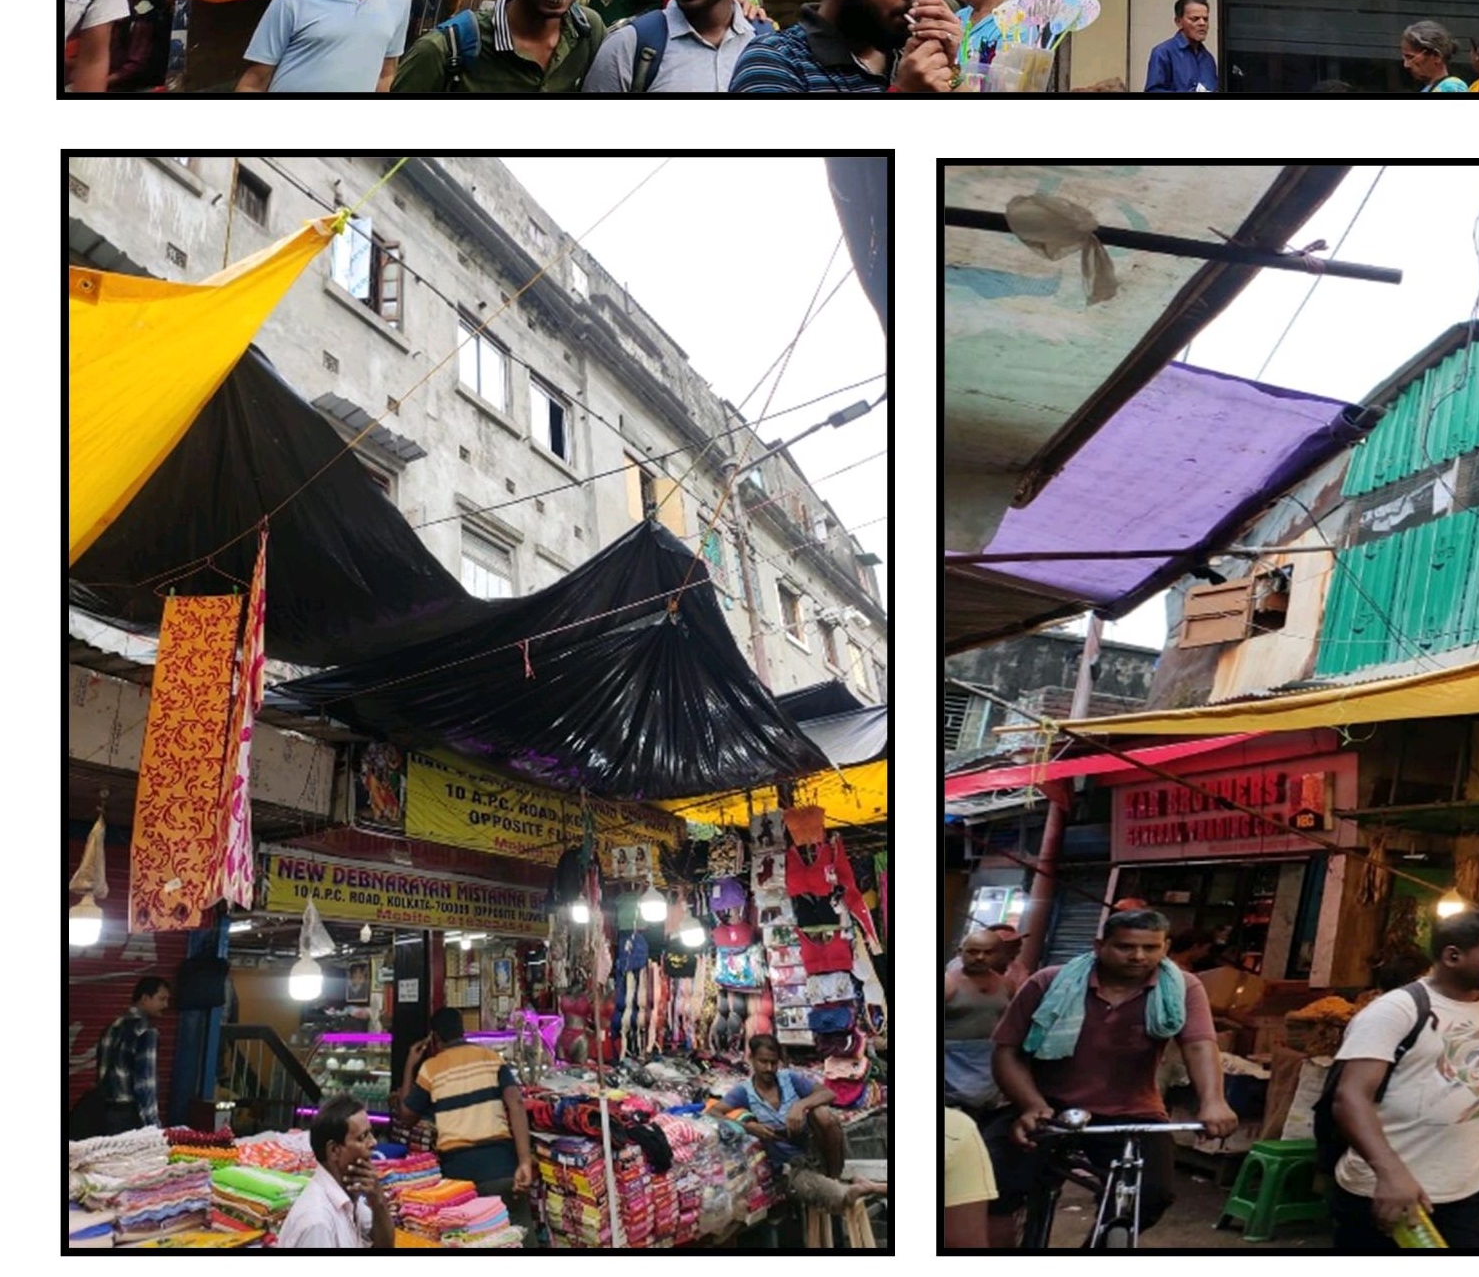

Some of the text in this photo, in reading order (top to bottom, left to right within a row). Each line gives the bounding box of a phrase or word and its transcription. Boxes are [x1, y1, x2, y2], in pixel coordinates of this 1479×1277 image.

[444, 783, 465, 801] 10
[471, 787, 514, 812] A.P.C.
[469, 810, 544, 837] OPPOSITE
[277, 858, 526, 908] NEW DEBNARAYAN MISTANNA
[294, 885, 308, 898] 10
[312, 887, 345, 903] A.P.C.
[376, 908, 432, 925] Mobile
